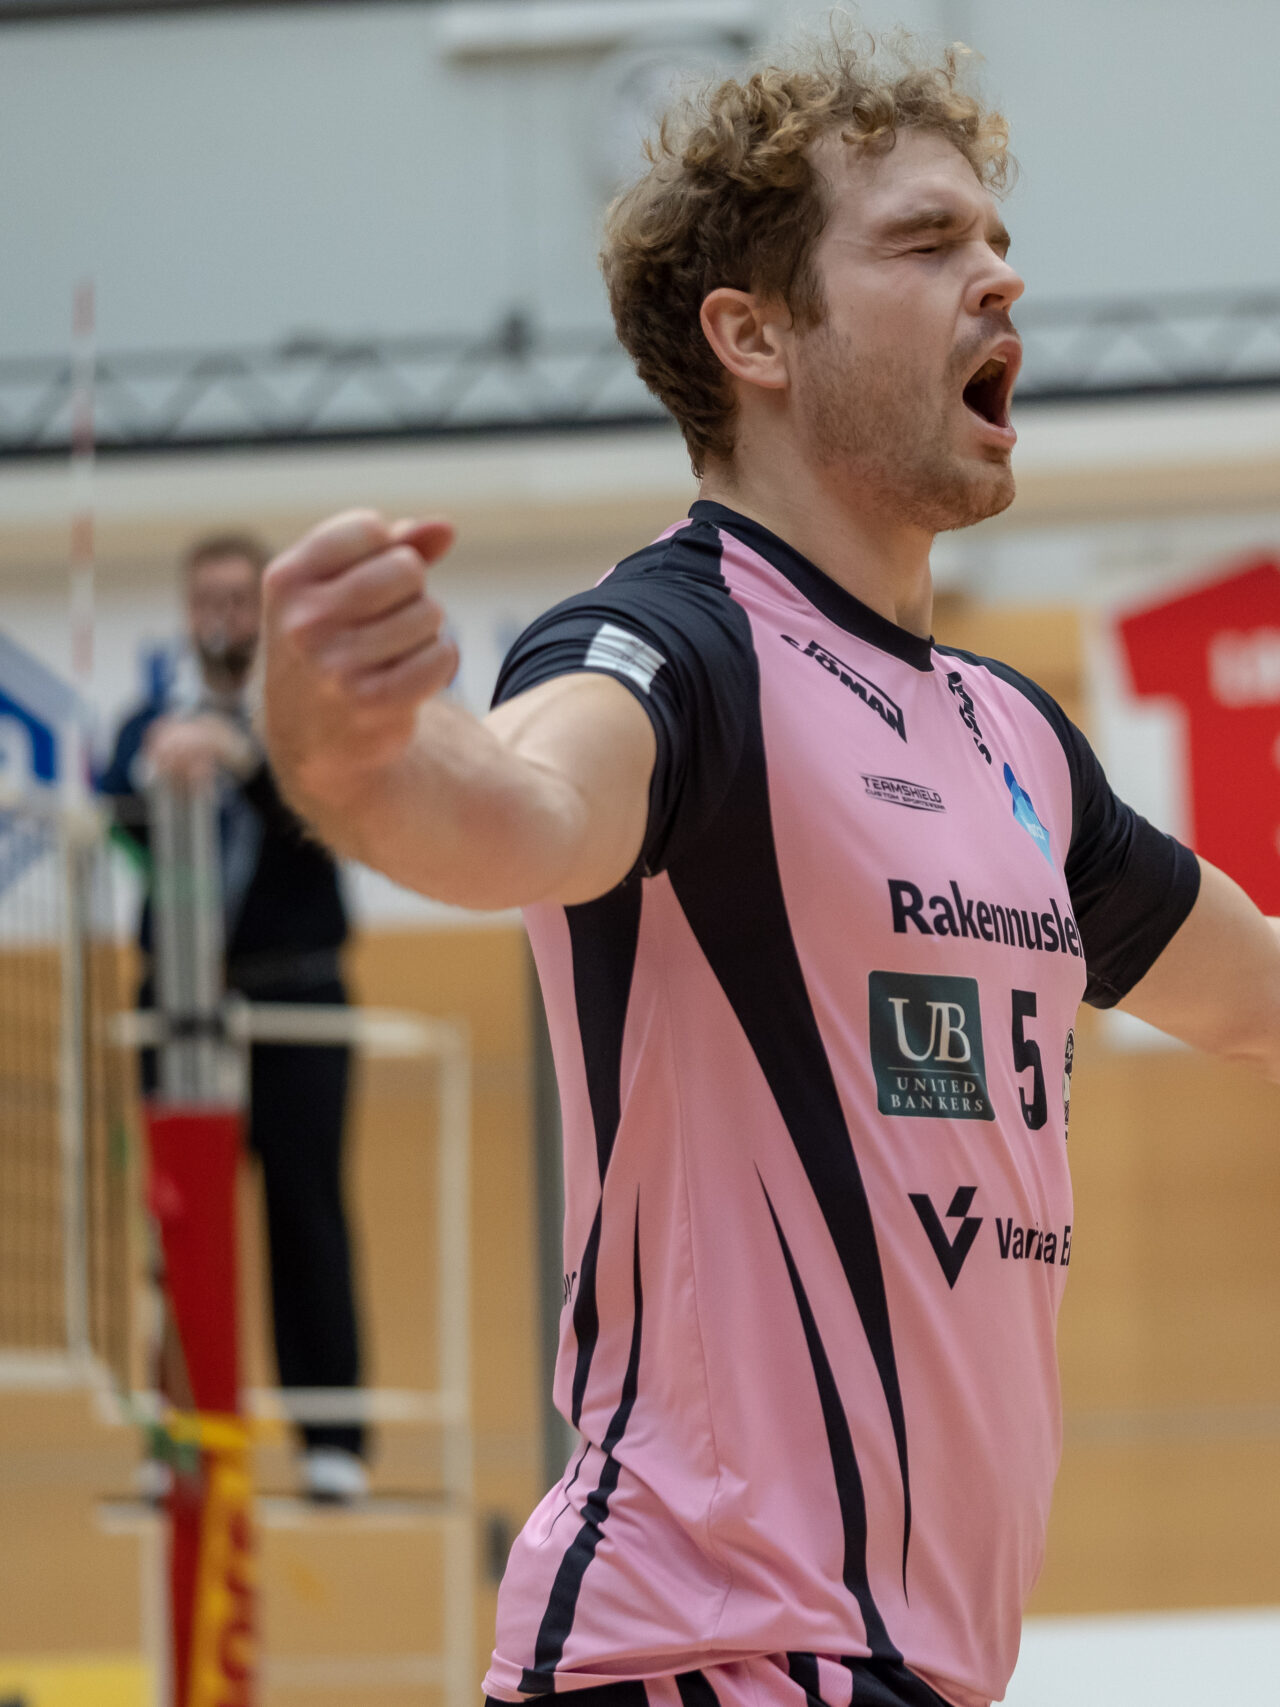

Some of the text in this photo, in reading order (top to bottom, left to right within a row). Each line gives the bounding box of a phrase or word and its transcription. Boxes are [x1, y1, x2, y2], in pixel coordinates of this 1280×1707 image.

[861, 776, 942, 803] TEAMSHIELD
[888, 998, 971, 1063] UB
[1011, 989, 1048, 1130] 5
[896, 1077, 976, 1094] UNITED
[891, 1094, 983, 1112] BANKERS
